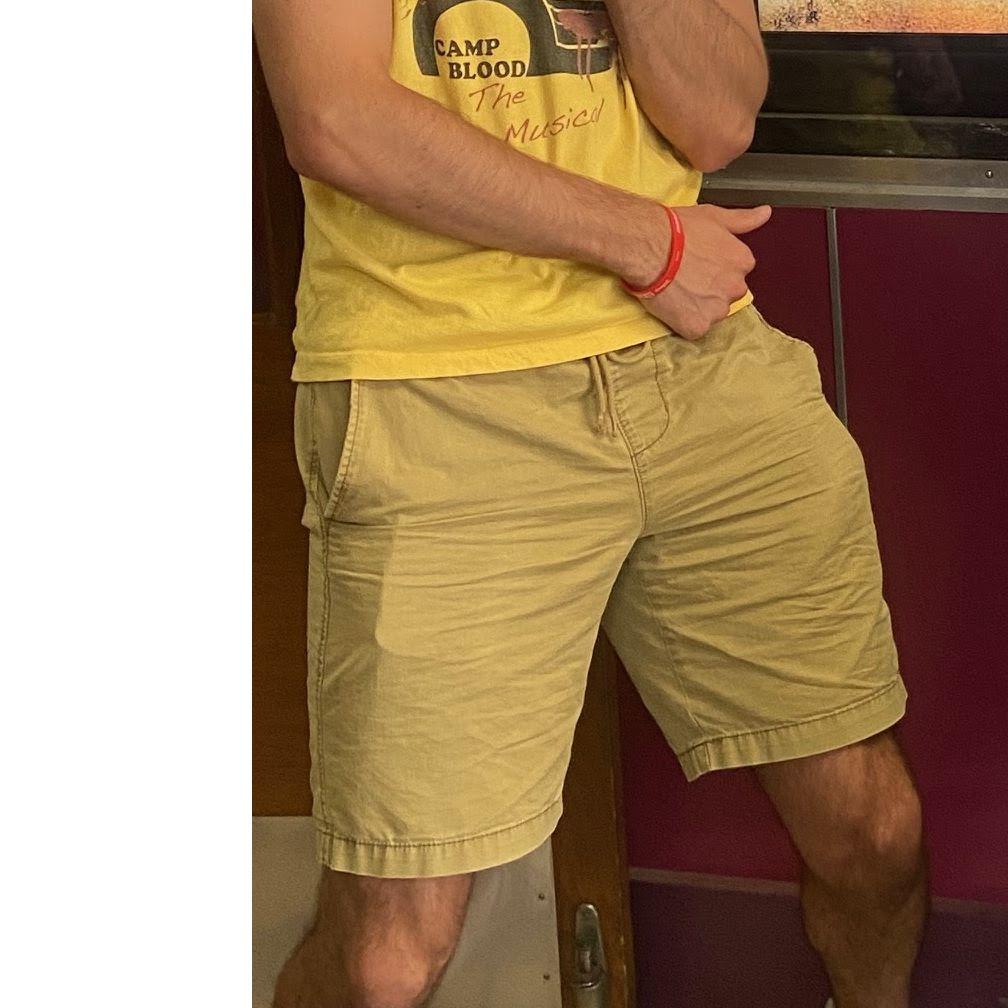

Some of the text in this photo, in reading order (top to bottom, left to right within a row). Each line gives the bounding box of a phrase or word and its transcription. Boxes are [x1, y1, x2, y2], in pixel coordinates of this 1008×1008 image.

[434, 38, 500, 57] CAMP
[448, 60, 526, 80] BLOOD
[469, 83, 526, 112] The
[504, 98, 605, 143] Musical
